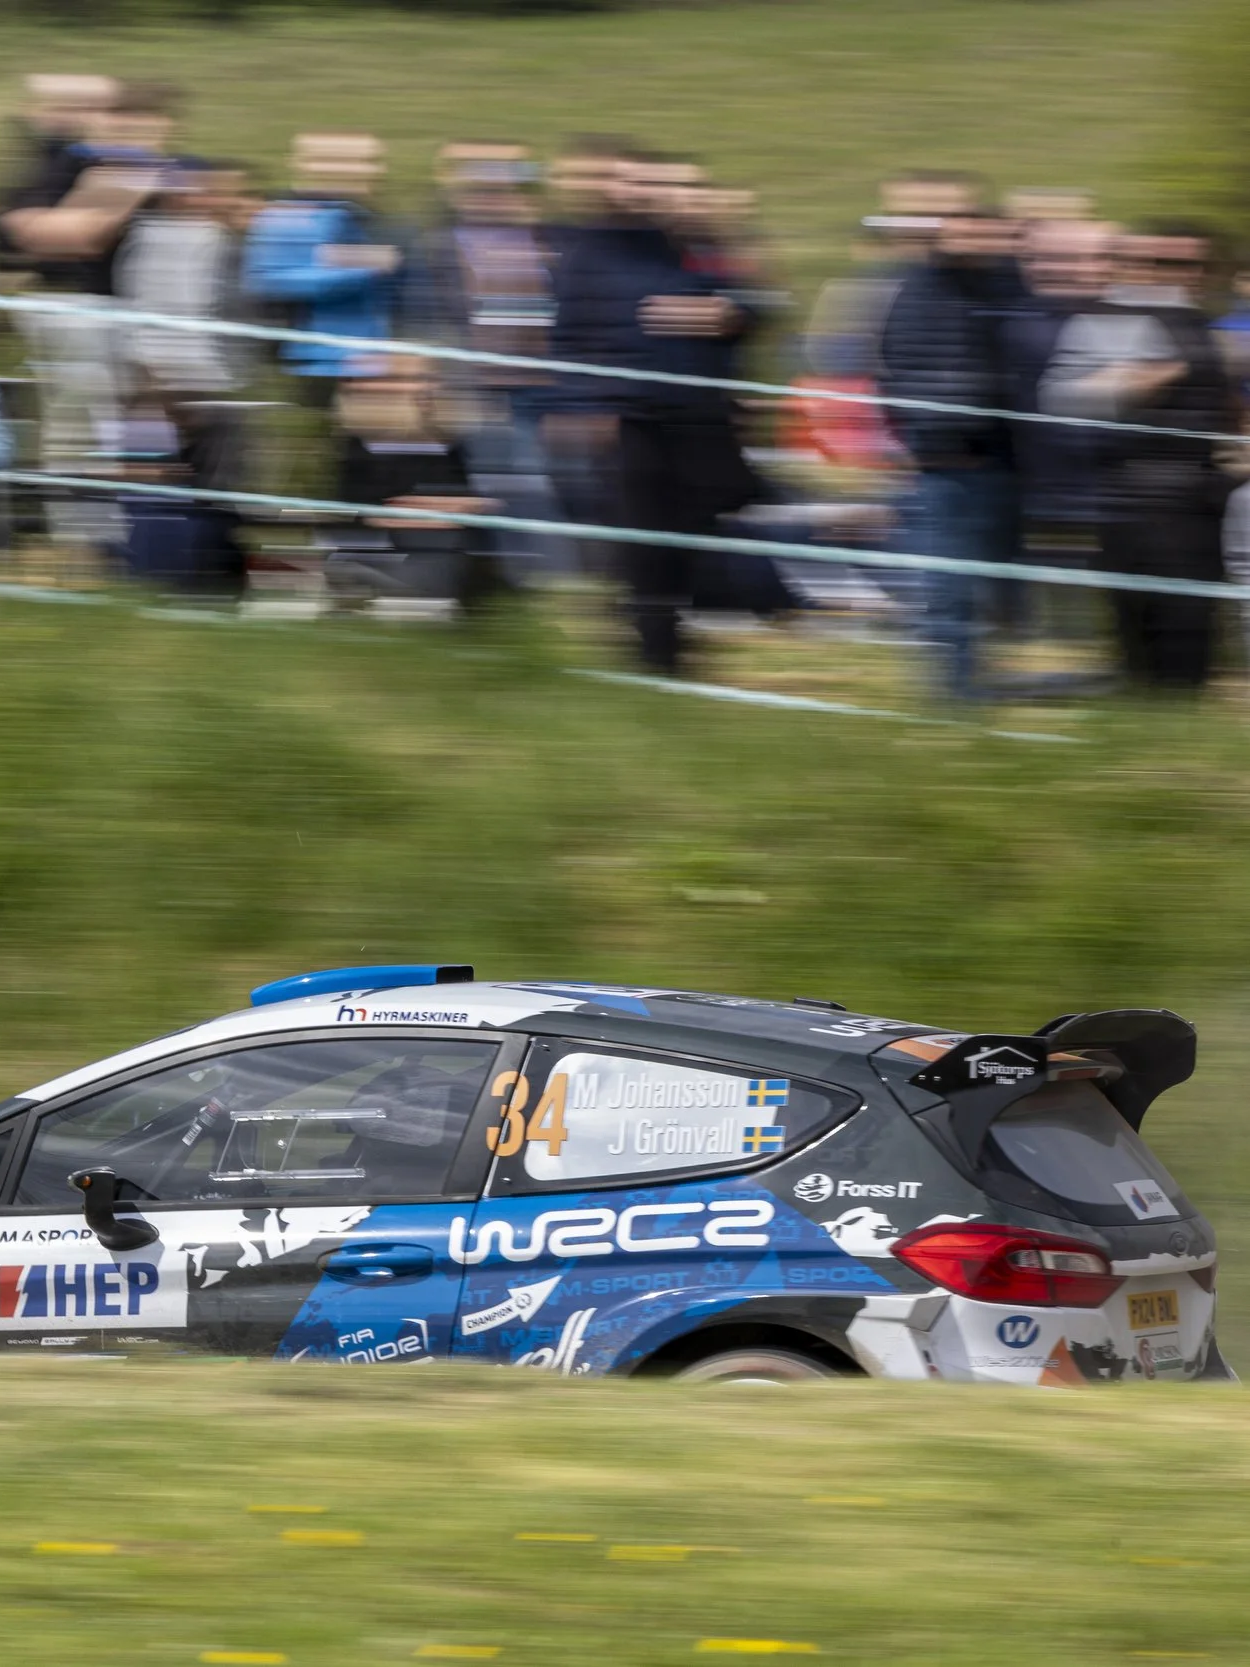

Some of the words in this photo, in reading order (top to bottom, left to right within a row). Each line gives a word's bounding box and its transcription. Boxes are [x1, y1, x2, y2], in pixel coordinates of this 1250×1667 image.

[372, 1011, 468, 1024] HYRMASKINER
[573, 1074, 599, 1110] M
[606, 1072, 739, 1110] Johansson
[486, 1071, 568, 1157] 34
[608, 1121, 624, 1155] J
[634, 1118, 736, 1155] Grönvall
[836, 1180, 897, 1198] Forss
[897, 1181, 923, 1199] IT
[448, 1200, 776, 1265] WRC2
[53, 1262, 159, 1317] HEP
[466, 1304, 514, 1329] CHAMPION
[338, 1328, 375, 1348] FIA
